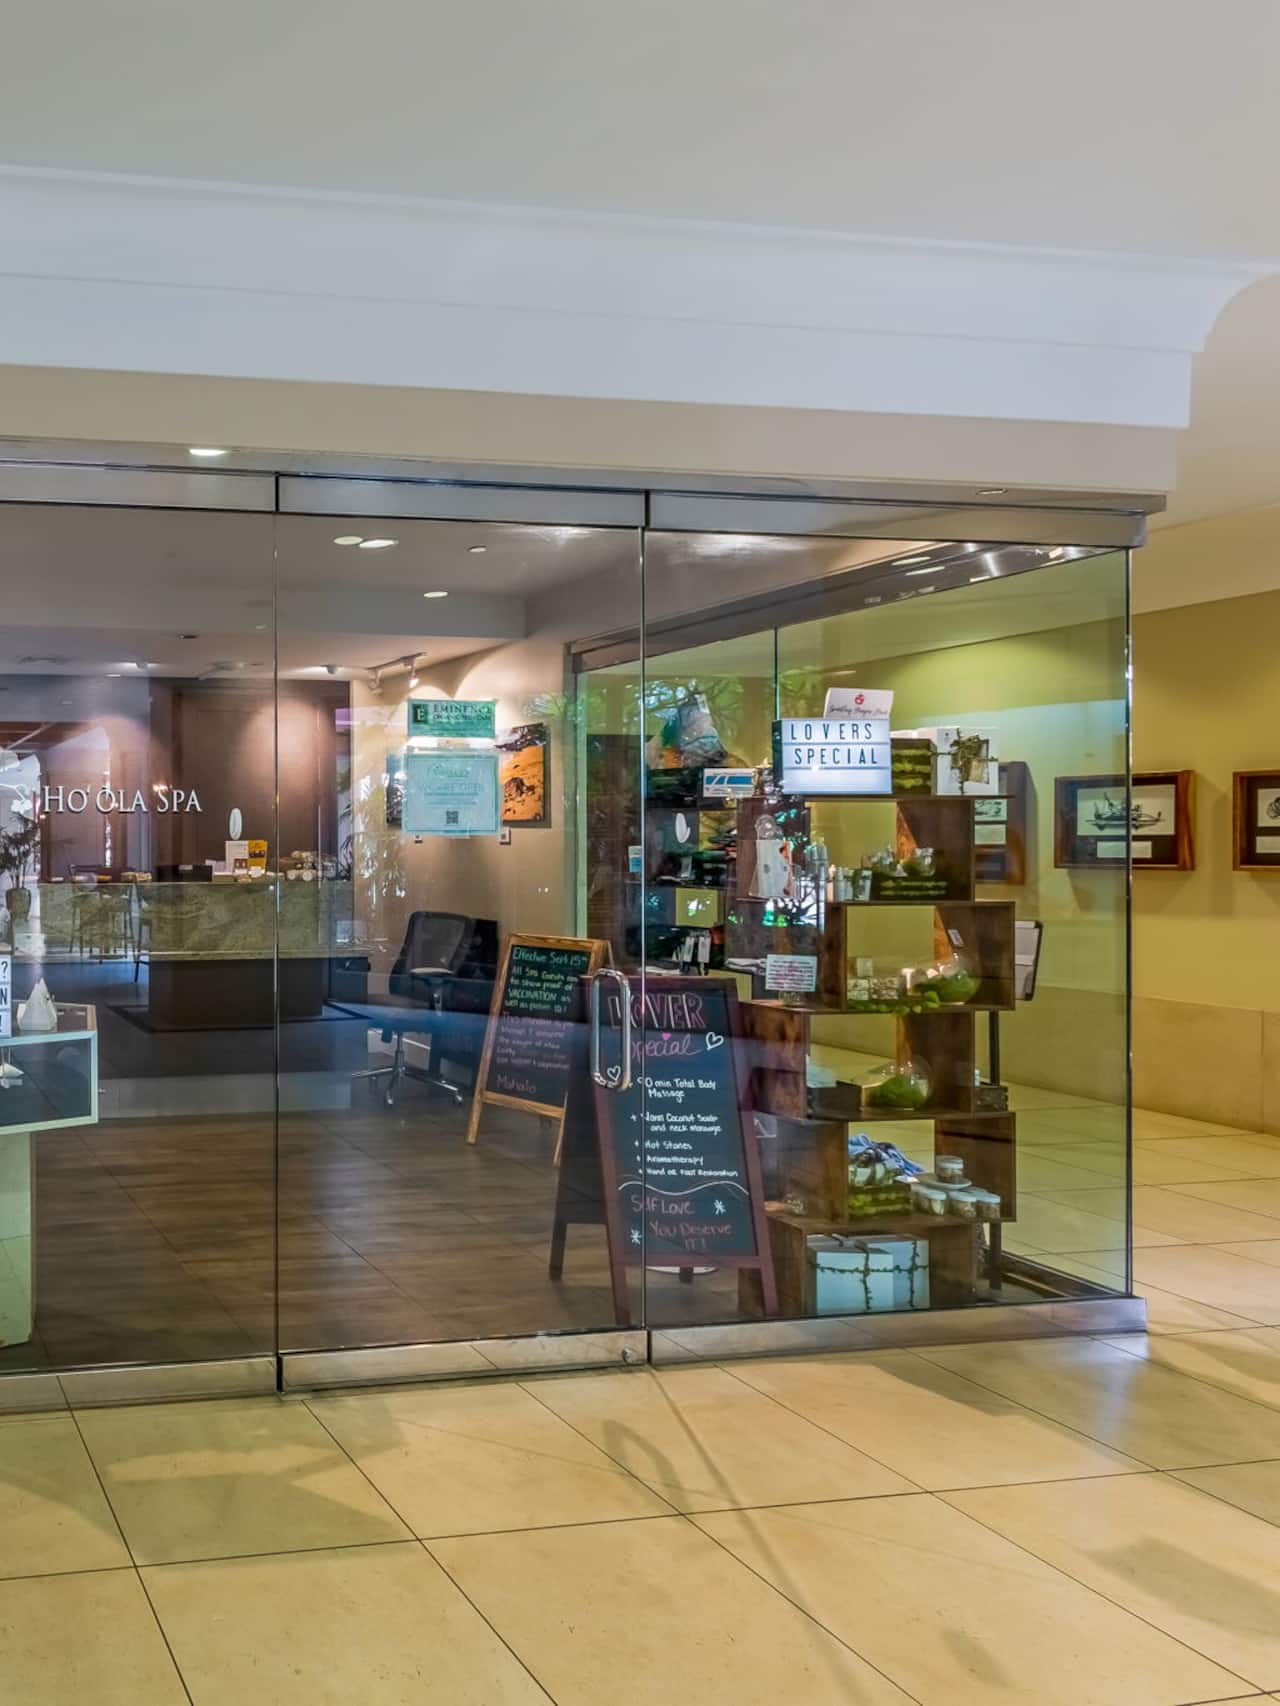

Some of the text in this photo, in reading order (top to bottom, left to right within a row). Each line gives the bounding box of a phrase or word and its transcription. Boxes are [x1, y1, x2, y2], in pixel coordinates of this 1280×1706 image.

[791, 723, 872, 740] LOVERS
[794, 748, 878, 765] SPECIAL
[157, 789, 203, 813] SPA
[508, 988, 557, 1002] VACCINATION
[673, 1078, 696, 1088] Total
[698, 1080, 717, 1090] Body
[648, 1088, 685, 1103] Massage
[650, 1124, 666, 1132] and
[649, 1220, 677, 1237] You
